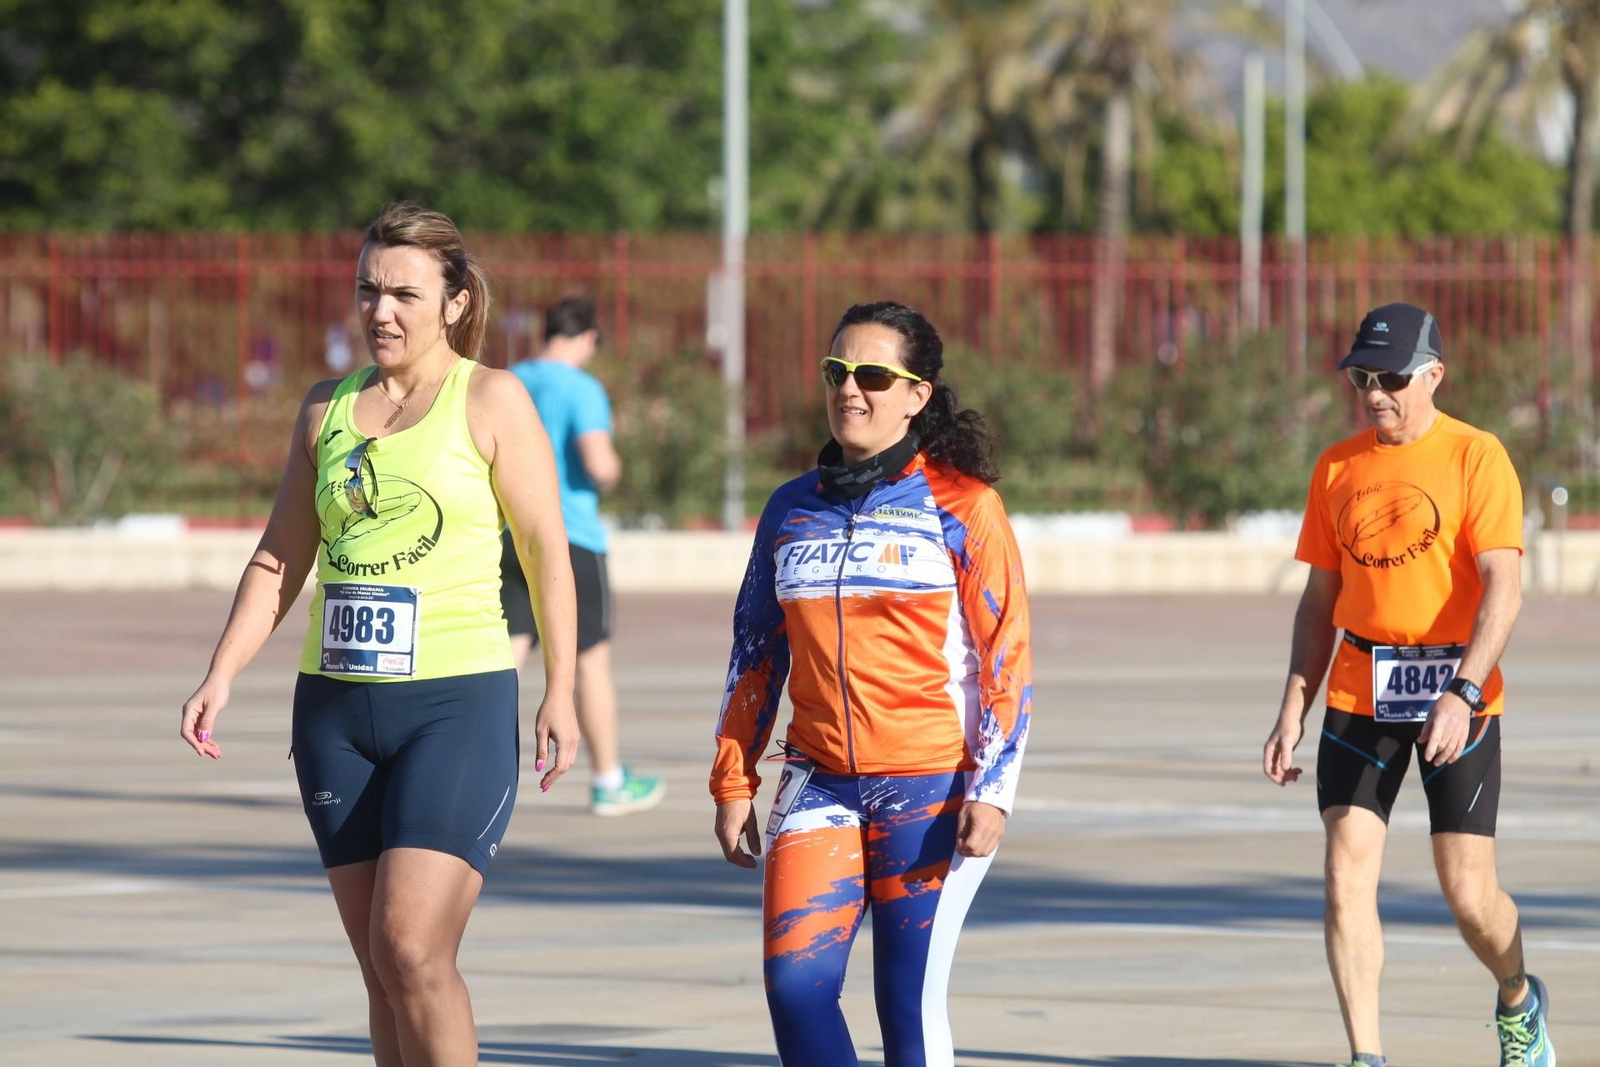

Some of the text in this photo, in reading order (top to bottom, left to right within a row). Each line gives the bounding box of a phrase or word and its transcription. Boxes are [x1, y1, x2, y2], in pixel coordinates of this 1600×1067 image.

[337, 535, 436, 576] Correr Fácil
[783, 541, 875, 567] FIATC
[1362, 528, 1438, 569] Correr Fácil
[329, 605, 395, 644] 4983
[348, 664, 374, 672] Unidas
[1387, 664, 1454, 695] 4842
[774, 769, 793, 805] 2
